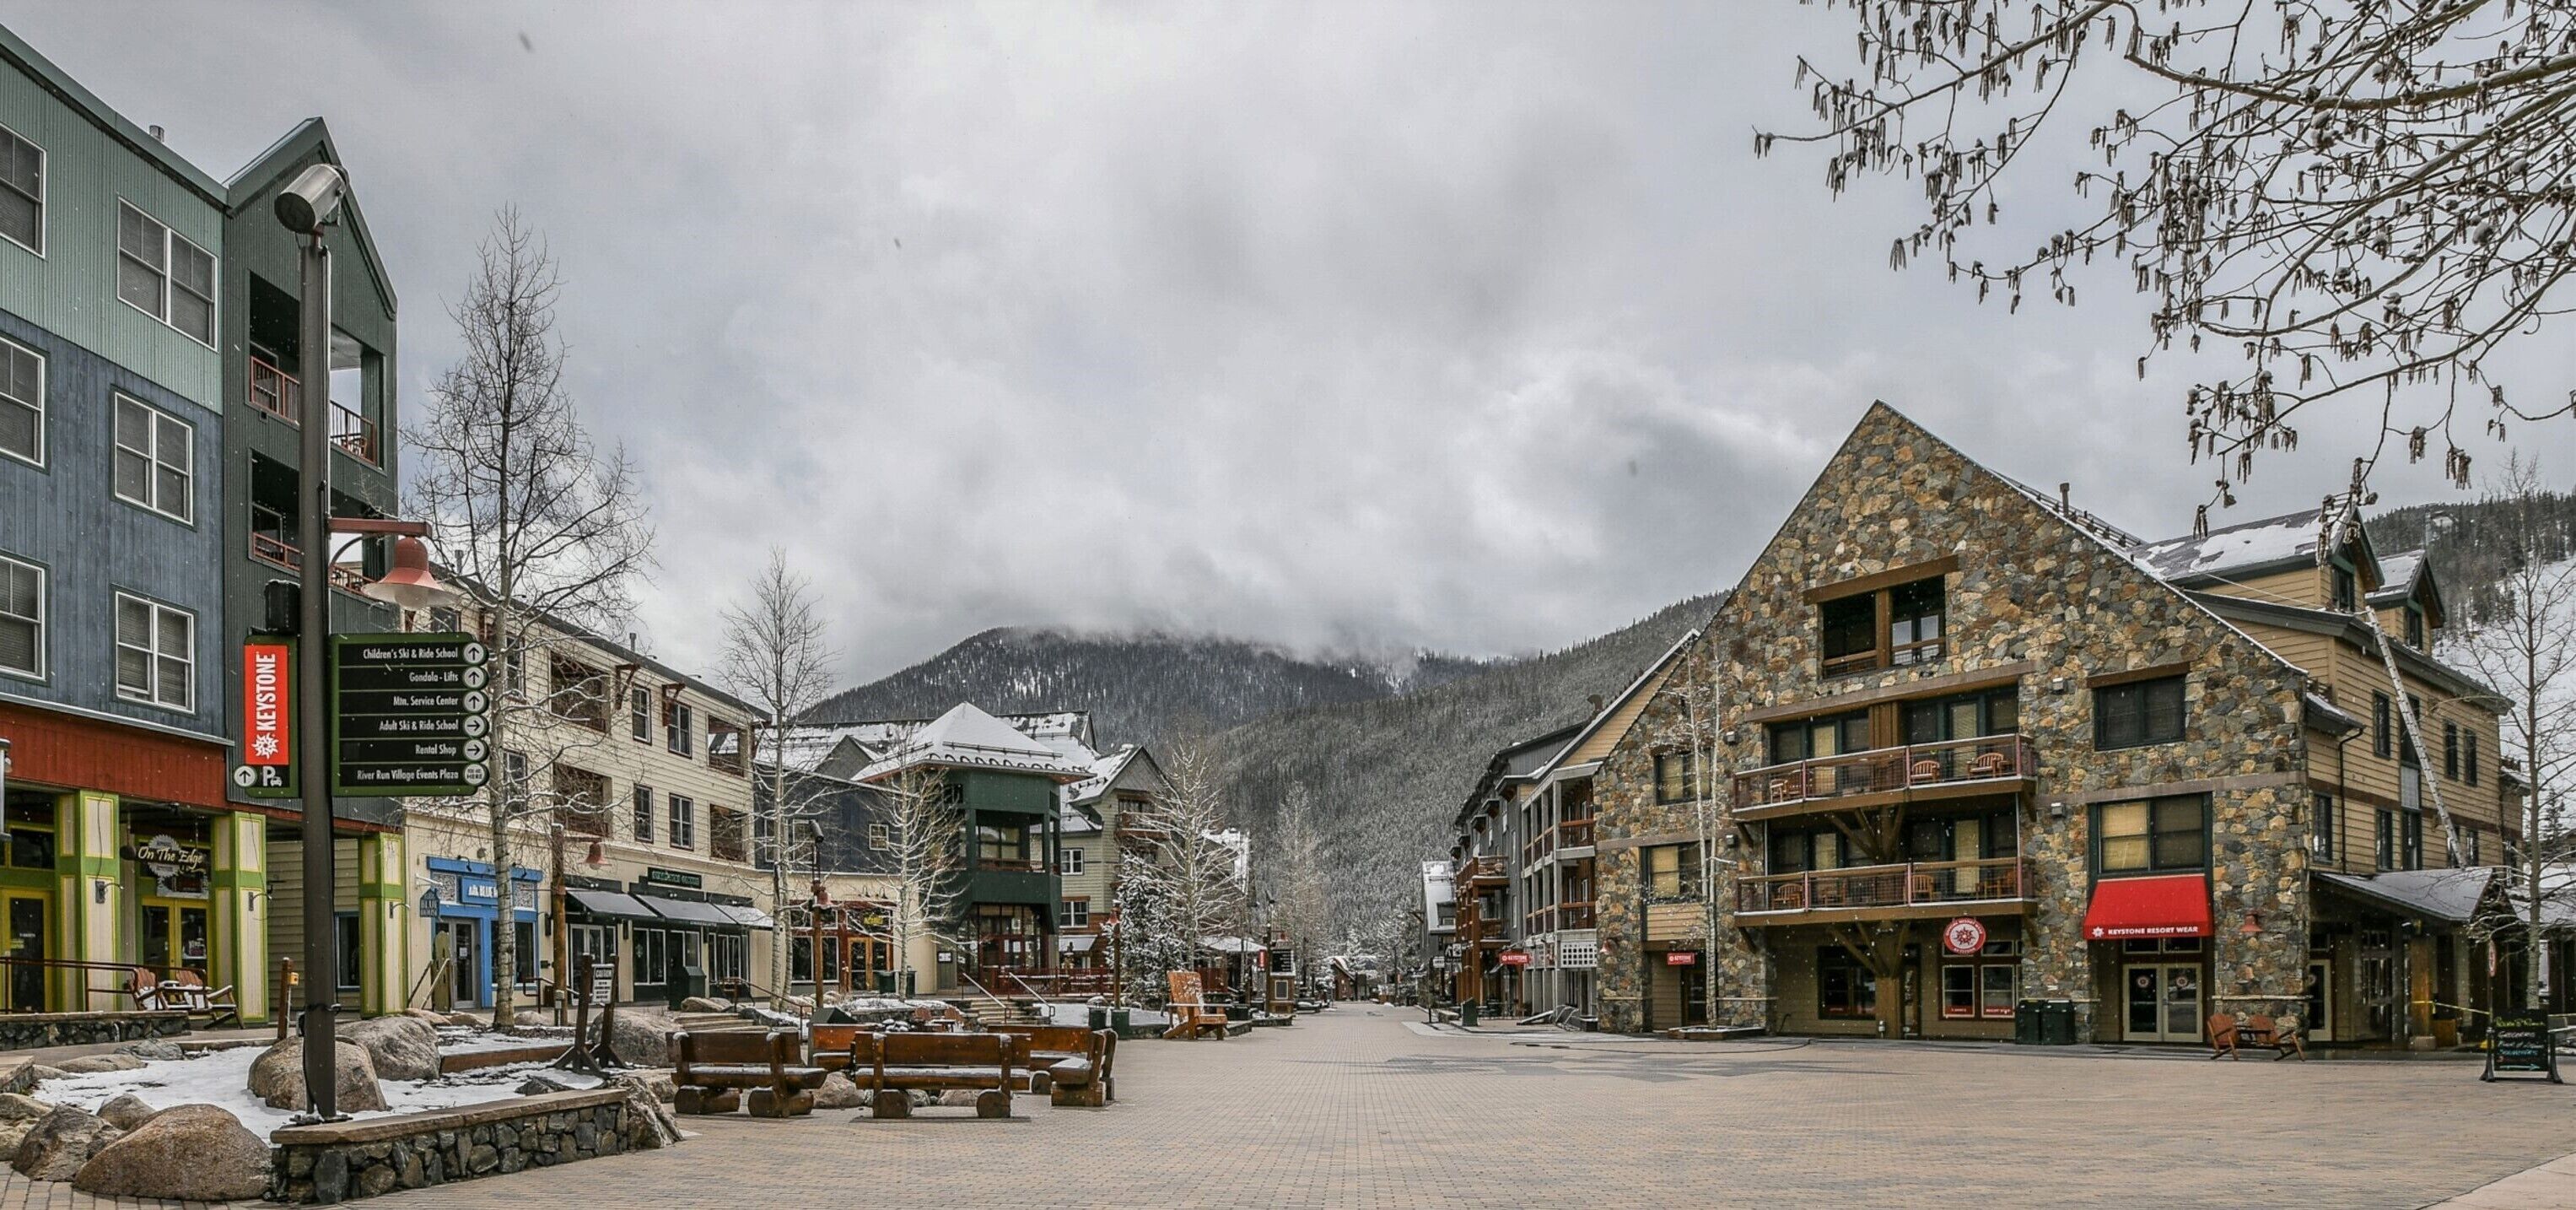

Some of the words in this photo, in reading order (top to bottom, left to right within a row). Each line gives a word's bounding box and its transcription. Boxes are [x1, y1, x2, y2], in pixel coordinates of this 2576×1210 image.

[363, 648, 397, 660] Children's
[399, 648, 410, 659] Ski
[411, 649, 417, 658] &
[419, 648, 434, 659] Ride
[435, 647, 458, 658] School
[409, 672, 438, 682] Gondola
[444, 672, 458, 682] Lifts
[256, 652, 276, 732] KEYSTONE
[393, 696, 409, 706] Mtn.
[411, 695, 434, 706] Service
[436, 695, 458, 705] Center
[380, 720, 398, 731] Adult
[399, 720, 410, 731] Ski
[412, 721, 417, 731] &
[419, 720, 434, 731] Ride
[436, 719, 458, 730] School
[415, 744, 437, 754] Rental
[439, 743, 457, 756] Shop
[357, 770, 375, 781] River
[376, 770, 390, 780] Run
[391, 769, 415, 782] Village
[416, 769, 438, 780] Events
[439, 769, 458, 779] Plaza
[138, 846, 154, 859] On
[157, 847, 176, 861] The
[179, 848, 203, 870] Edge
